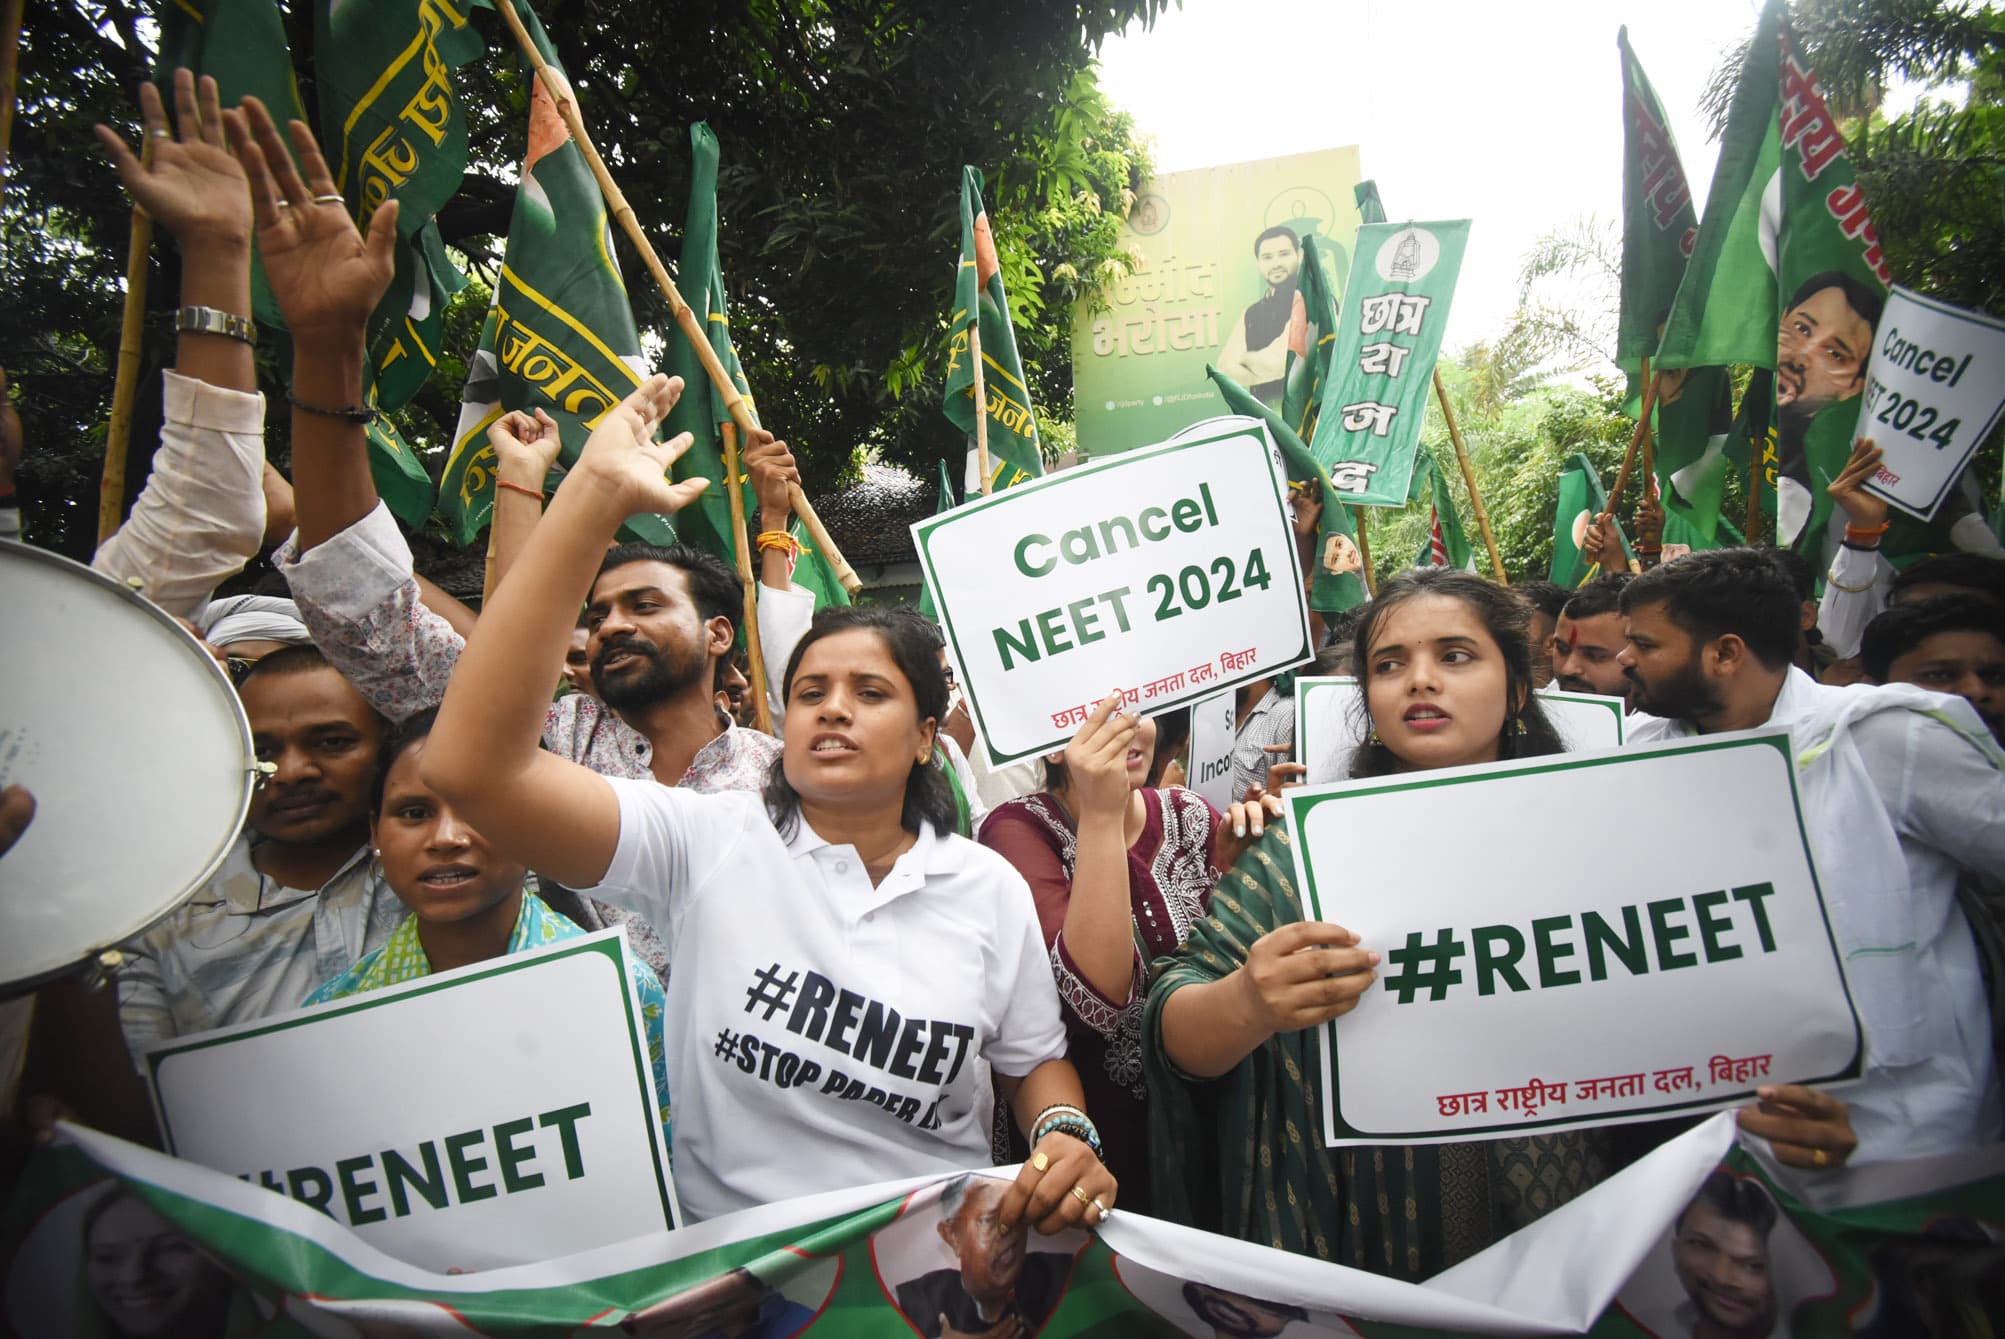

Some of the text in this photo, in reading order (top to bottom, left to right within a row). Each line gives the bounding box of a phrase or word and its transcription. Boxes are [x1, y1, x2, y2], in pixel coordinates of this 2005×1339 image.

[1360, 292, 1430, 336] छात्र
[1883, 327, 1973, 388] Cancel
[1877, 392, 1961, 451] 2024
[1014, 482, 1219, 578] Cancel
[992, 547, 1271, 671] NEET 2024
[1051, 705, 1088, 729] छात्र
[1143, 672, 1186, 699] जनता
[1188, 663, 1218, 685] दल,
[1220, 648, 1257, 674] बिहार
[1384, 881, 1777, 1005] #RENEET
[714, 1028, 822, 1089] #STOP
[744, 963, 975, 1086] #RENEET
[1437, 1054, 1773, 1117] छात्र राष्ट्रीय जनता दल, बिहार
[237, 1102, 591, 1226] RENEET
